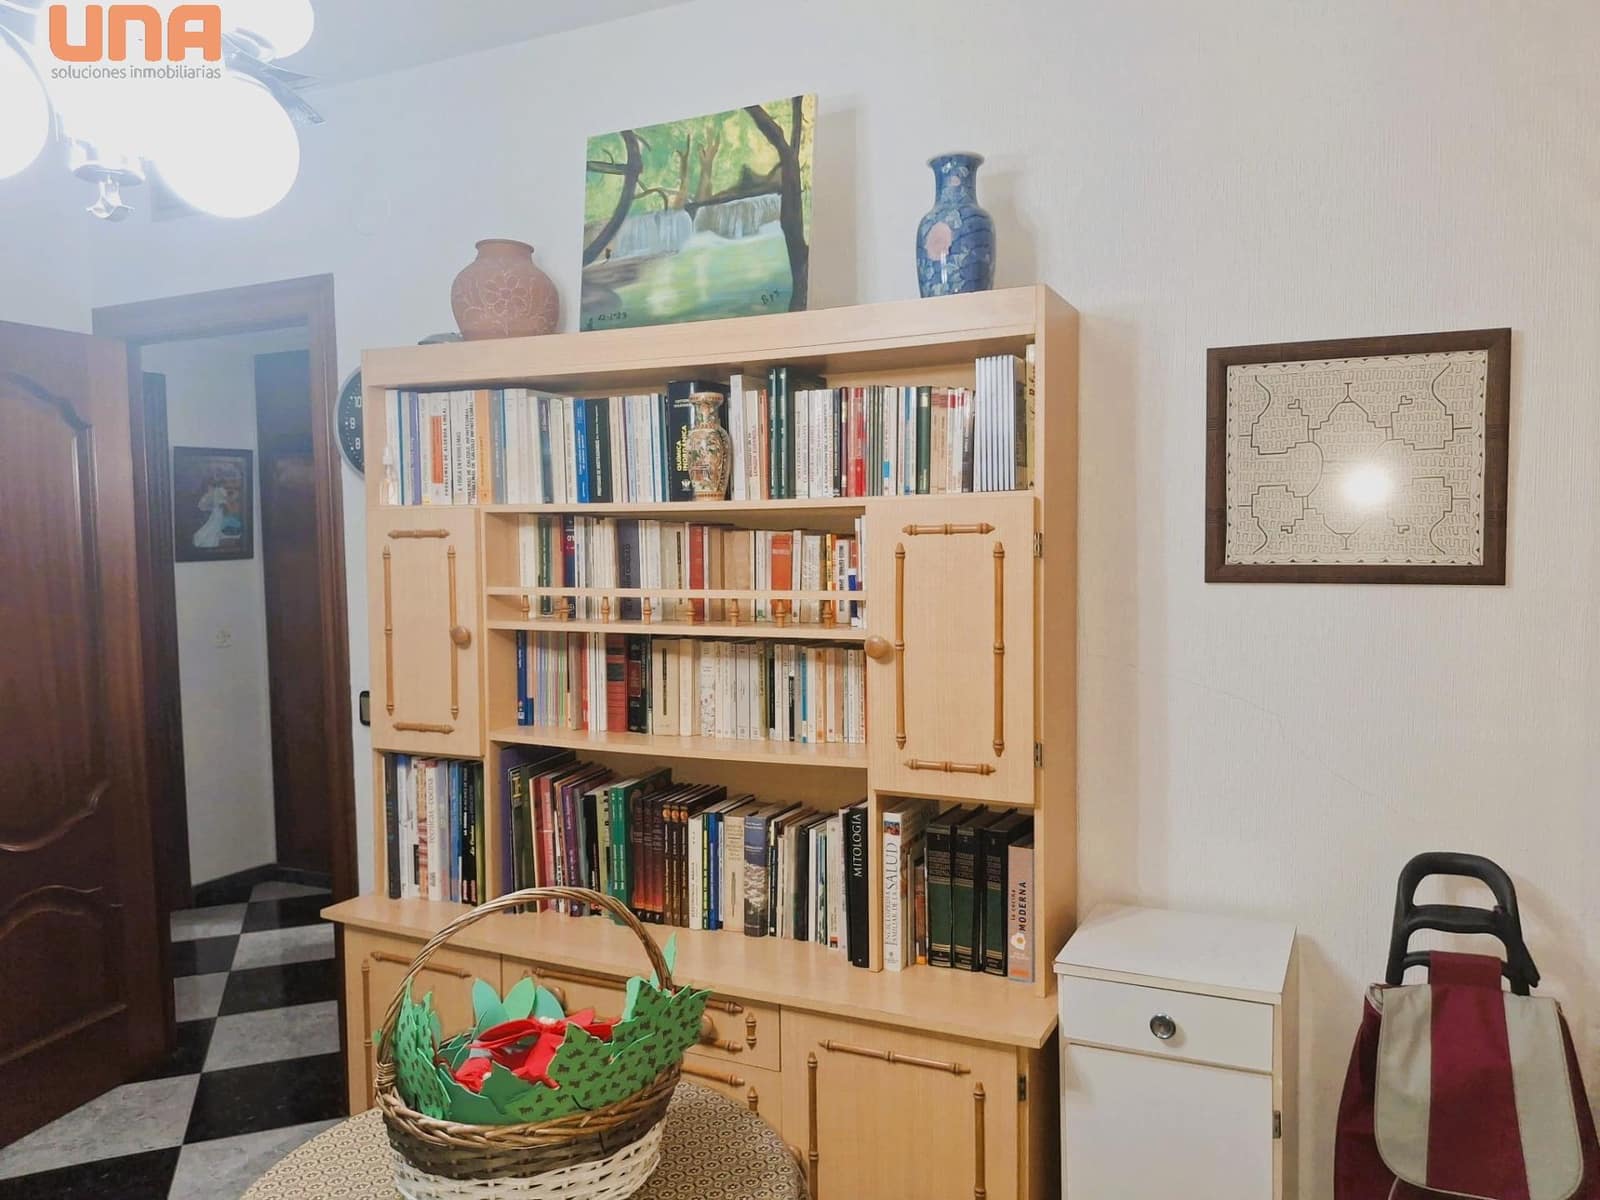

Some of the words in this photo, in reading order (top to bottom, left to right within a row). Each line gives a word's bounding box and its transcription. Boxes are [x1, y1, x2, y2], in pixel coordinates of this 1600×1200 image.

[354, 396, 362, 408] 10
[355, 437, 361, 450] 8
[852, 813, 864, 878] MITOLOGÍA
[885, 842, 898, 891] SALUD
[1017, 881, 1027, 931] MODERNA
